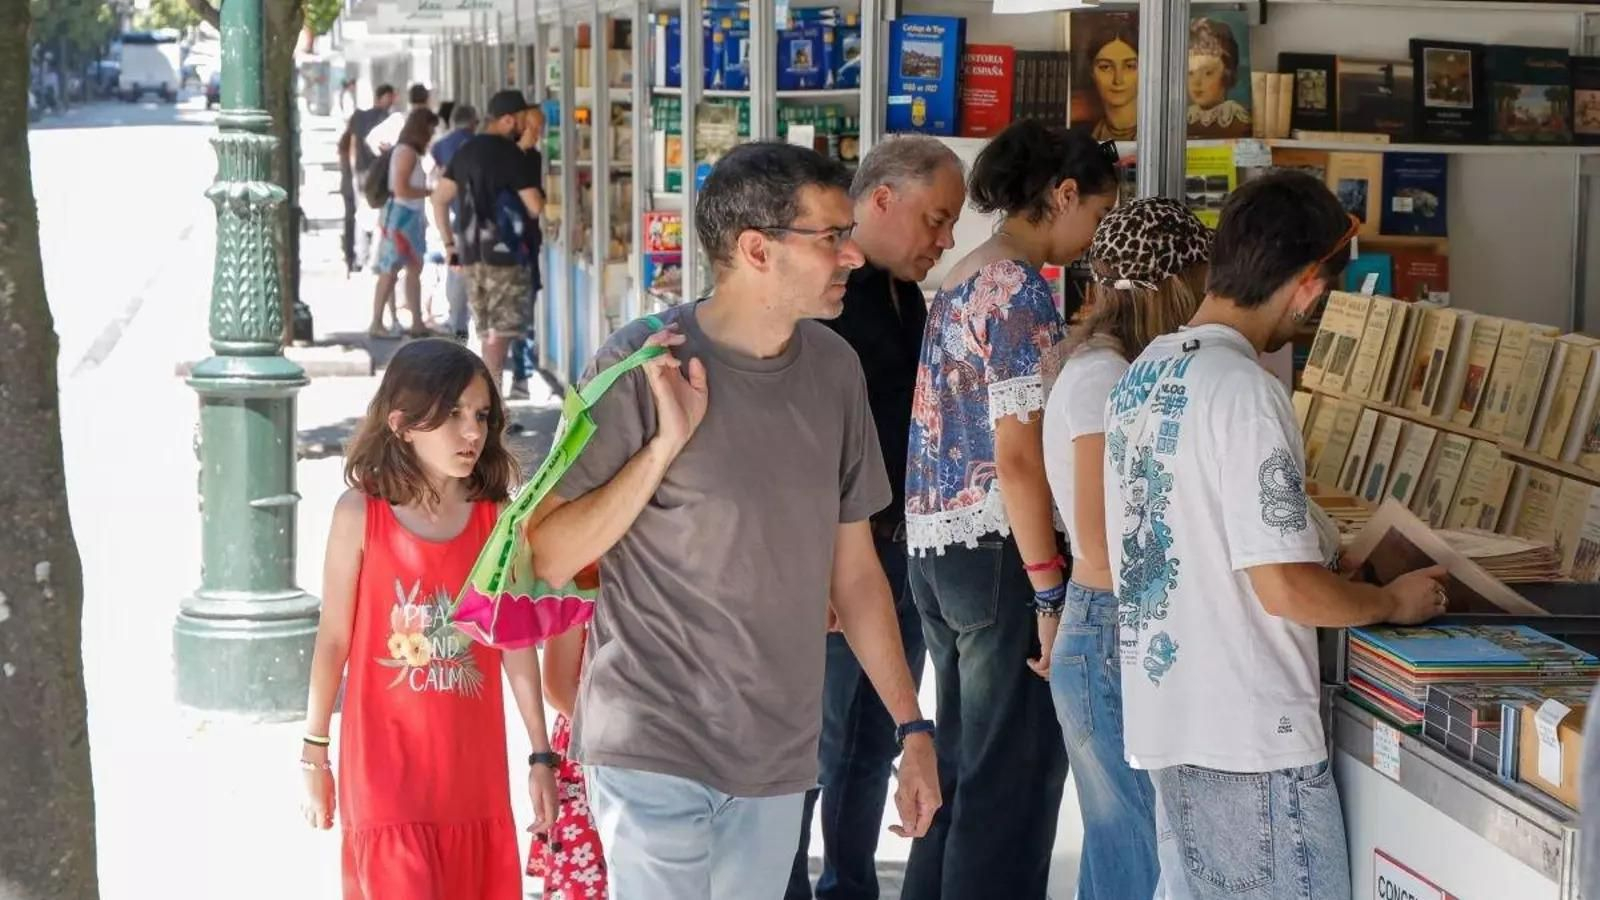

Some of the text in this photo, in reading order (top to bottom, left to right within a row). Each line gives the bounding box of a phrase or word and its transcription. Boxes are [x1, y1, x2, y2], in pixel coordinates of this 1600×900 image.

[404, 604, 447, 627] PEA
[416, 635, 460, 659] AND
[409, 667, 464, 692] CALM
[1378, 875, 1418, 900] CONC
